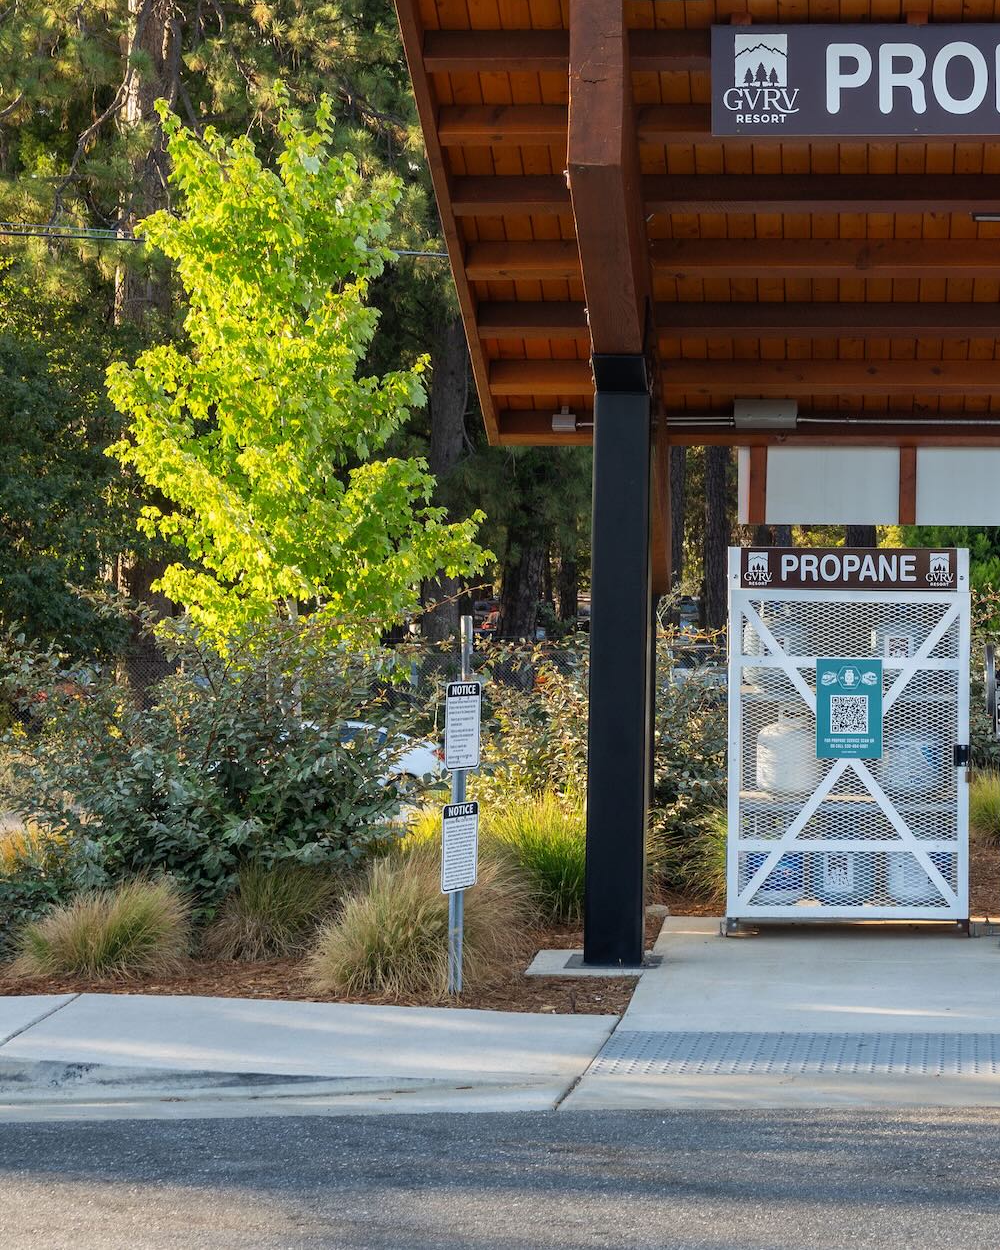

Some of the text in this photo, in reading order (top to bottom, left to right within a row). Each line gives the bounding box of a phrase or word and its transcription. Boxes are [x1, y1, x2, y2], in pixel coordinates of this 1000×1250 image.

[723, 88, 799, 113] GVRV
[736, 113, 787, 123] RESORT
[781, 554, 917, 582] PROPANE
[743, 572, 773, 582] GVRV
[925, 572, 954, 583] GVRV
[451, 684, 477, 696] NOTICE
[448, 803, 474, 817] NOTICE
